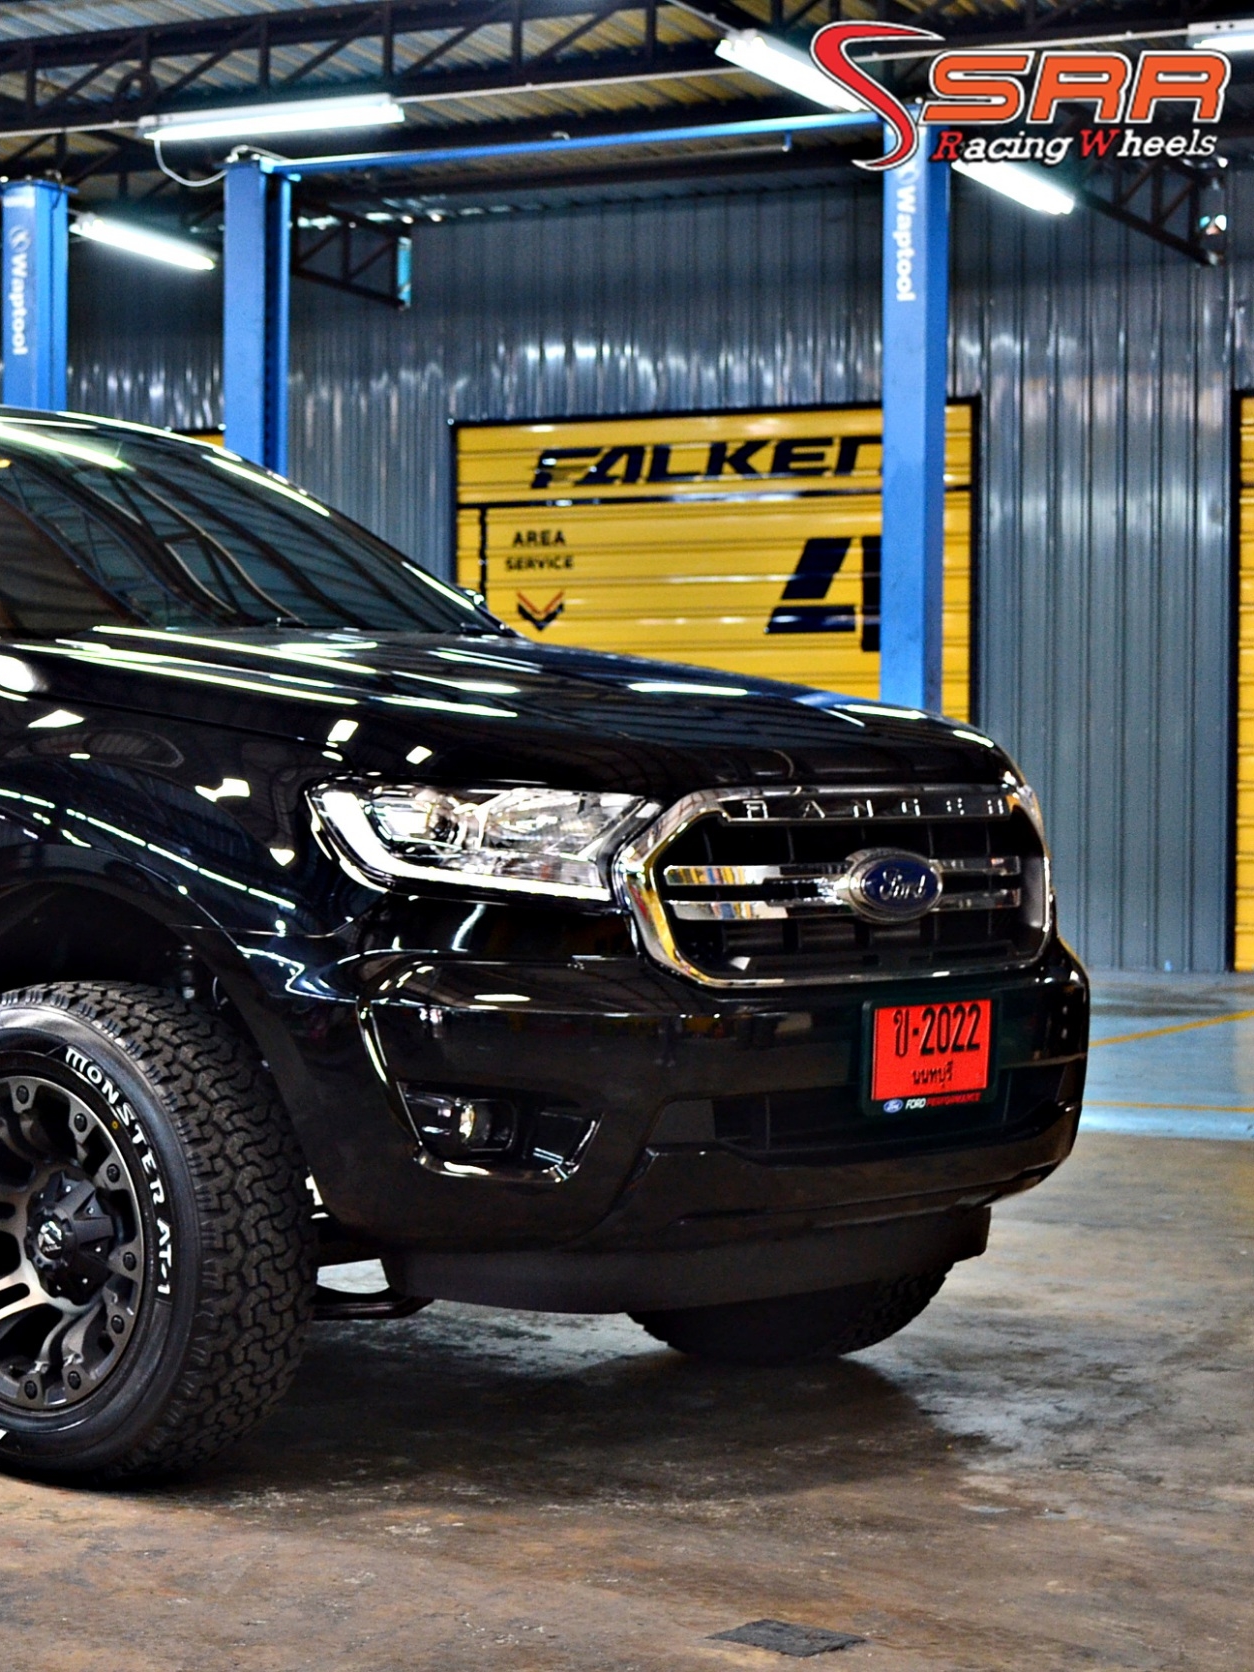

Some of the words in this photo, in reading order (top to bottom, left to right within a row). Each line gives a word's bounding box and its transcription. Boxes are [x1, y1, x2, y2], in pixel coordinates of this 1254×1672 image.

[893, 184, 916, 302] Waptool
[9, 252, 29, 355] Waptool
[506, 555, 575, 571] SERVICE
[513, 530, 566, 547] AREA
[878, 866, 928, 901] Ford
[64, 1047, 166, 1205] MONSTER
